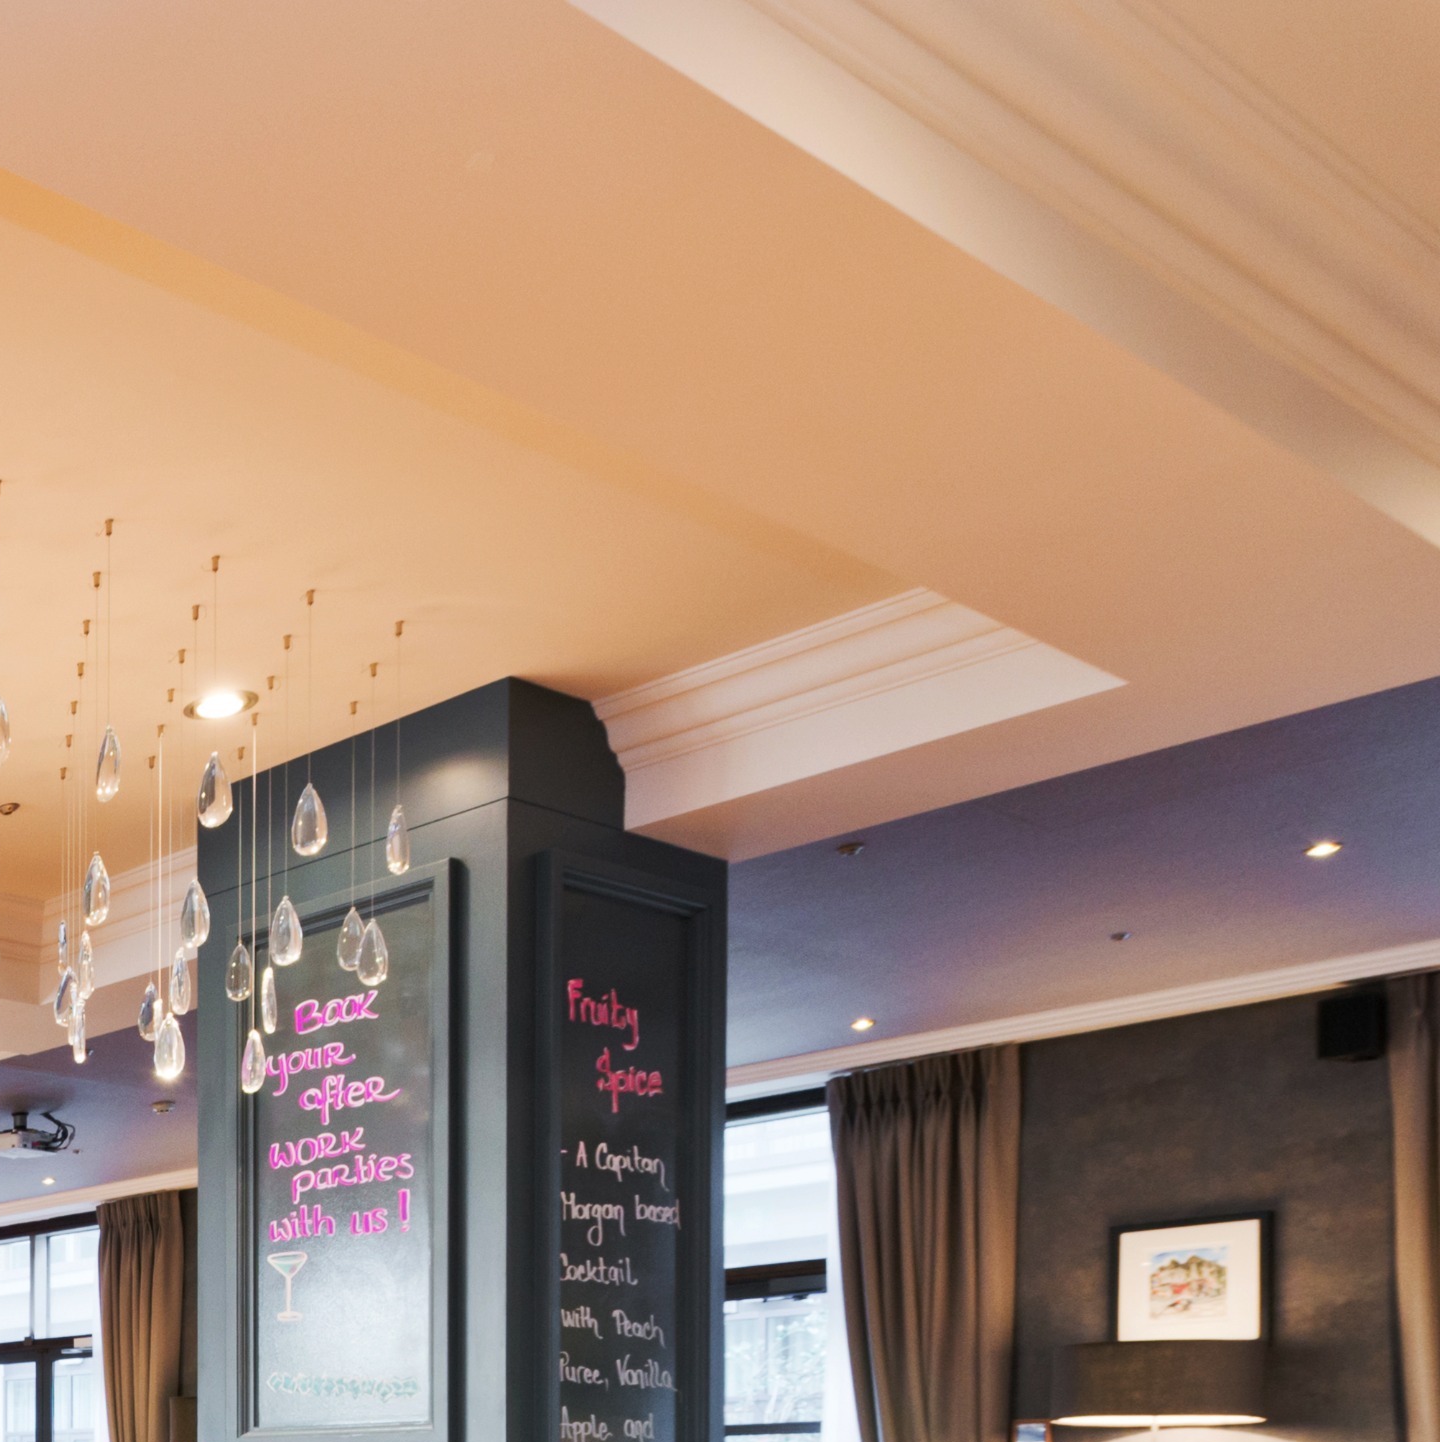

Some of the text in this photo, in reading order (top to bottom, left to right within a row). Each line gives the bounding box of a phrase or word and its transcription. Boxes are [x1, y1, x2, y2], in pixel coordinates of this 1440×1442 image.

[566, 977, 640, 1052] Fruity
[595, 1047, 664, 1114] Spice
[575, 1140, 589, 1169] A
[269, 1204, 336, 1243] with
[560, 1191, 682, 1247] Morgan based
[611, 1308, 666, 1349] Peach
[616, 1353, 679, 1392] Vanilla
